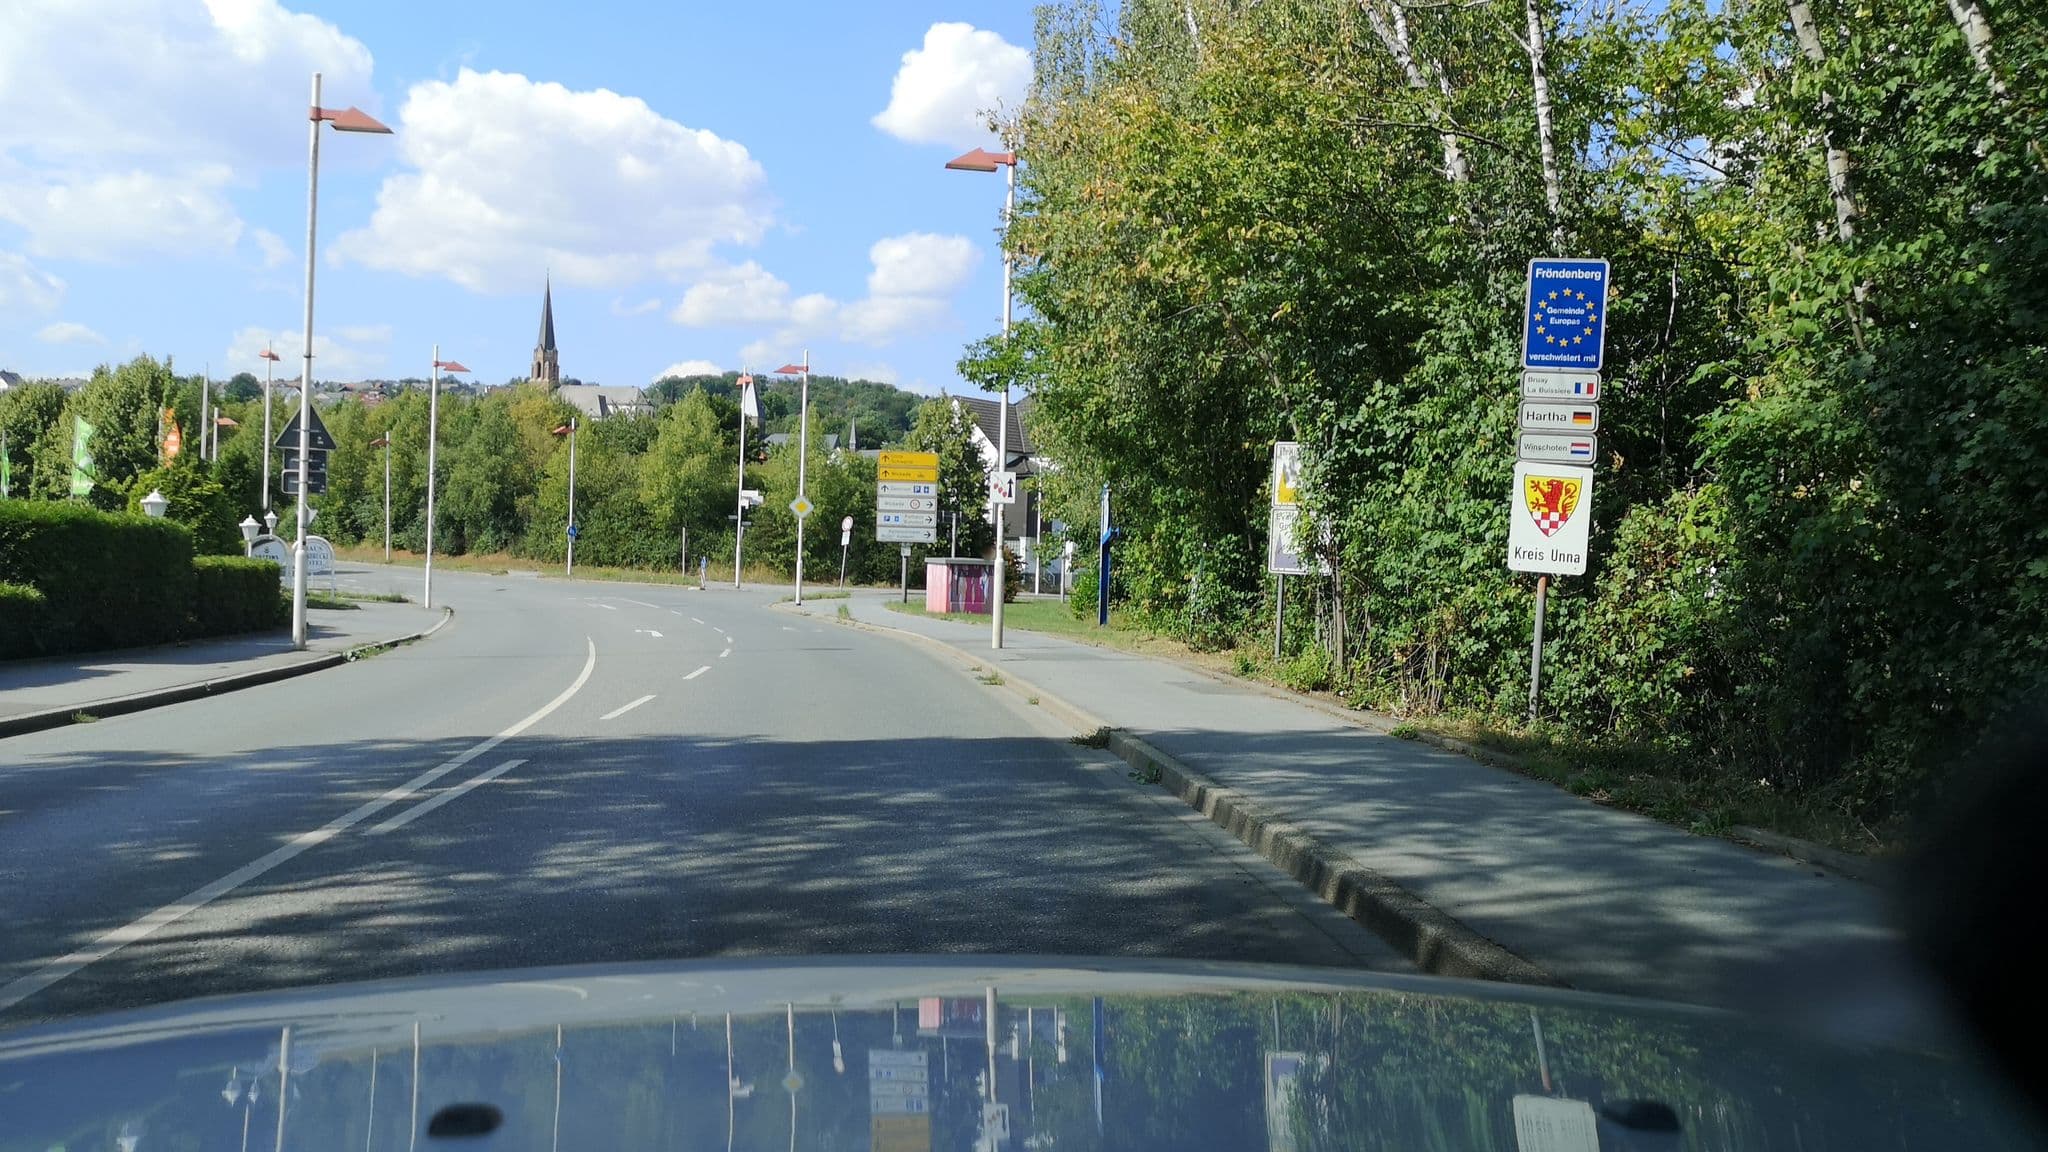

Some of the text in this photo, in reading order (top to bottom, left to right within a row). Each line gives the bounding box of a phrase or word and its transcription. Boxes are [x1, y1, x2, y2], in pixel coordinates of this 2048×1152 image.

[1535, 267, 1602, 281] Fröndenberg
[1546, 306, 1585, 315] Gemeinde
[1549, 317, 1581, 326] Europas
[1528, 353, 1596, 362] verschwistert mit
[1526, 411, 1567, 422] Hartha
[1523, 443, 1568, 452] Winschoten
[1514, 546, 1581, 563] Kreis Unna
